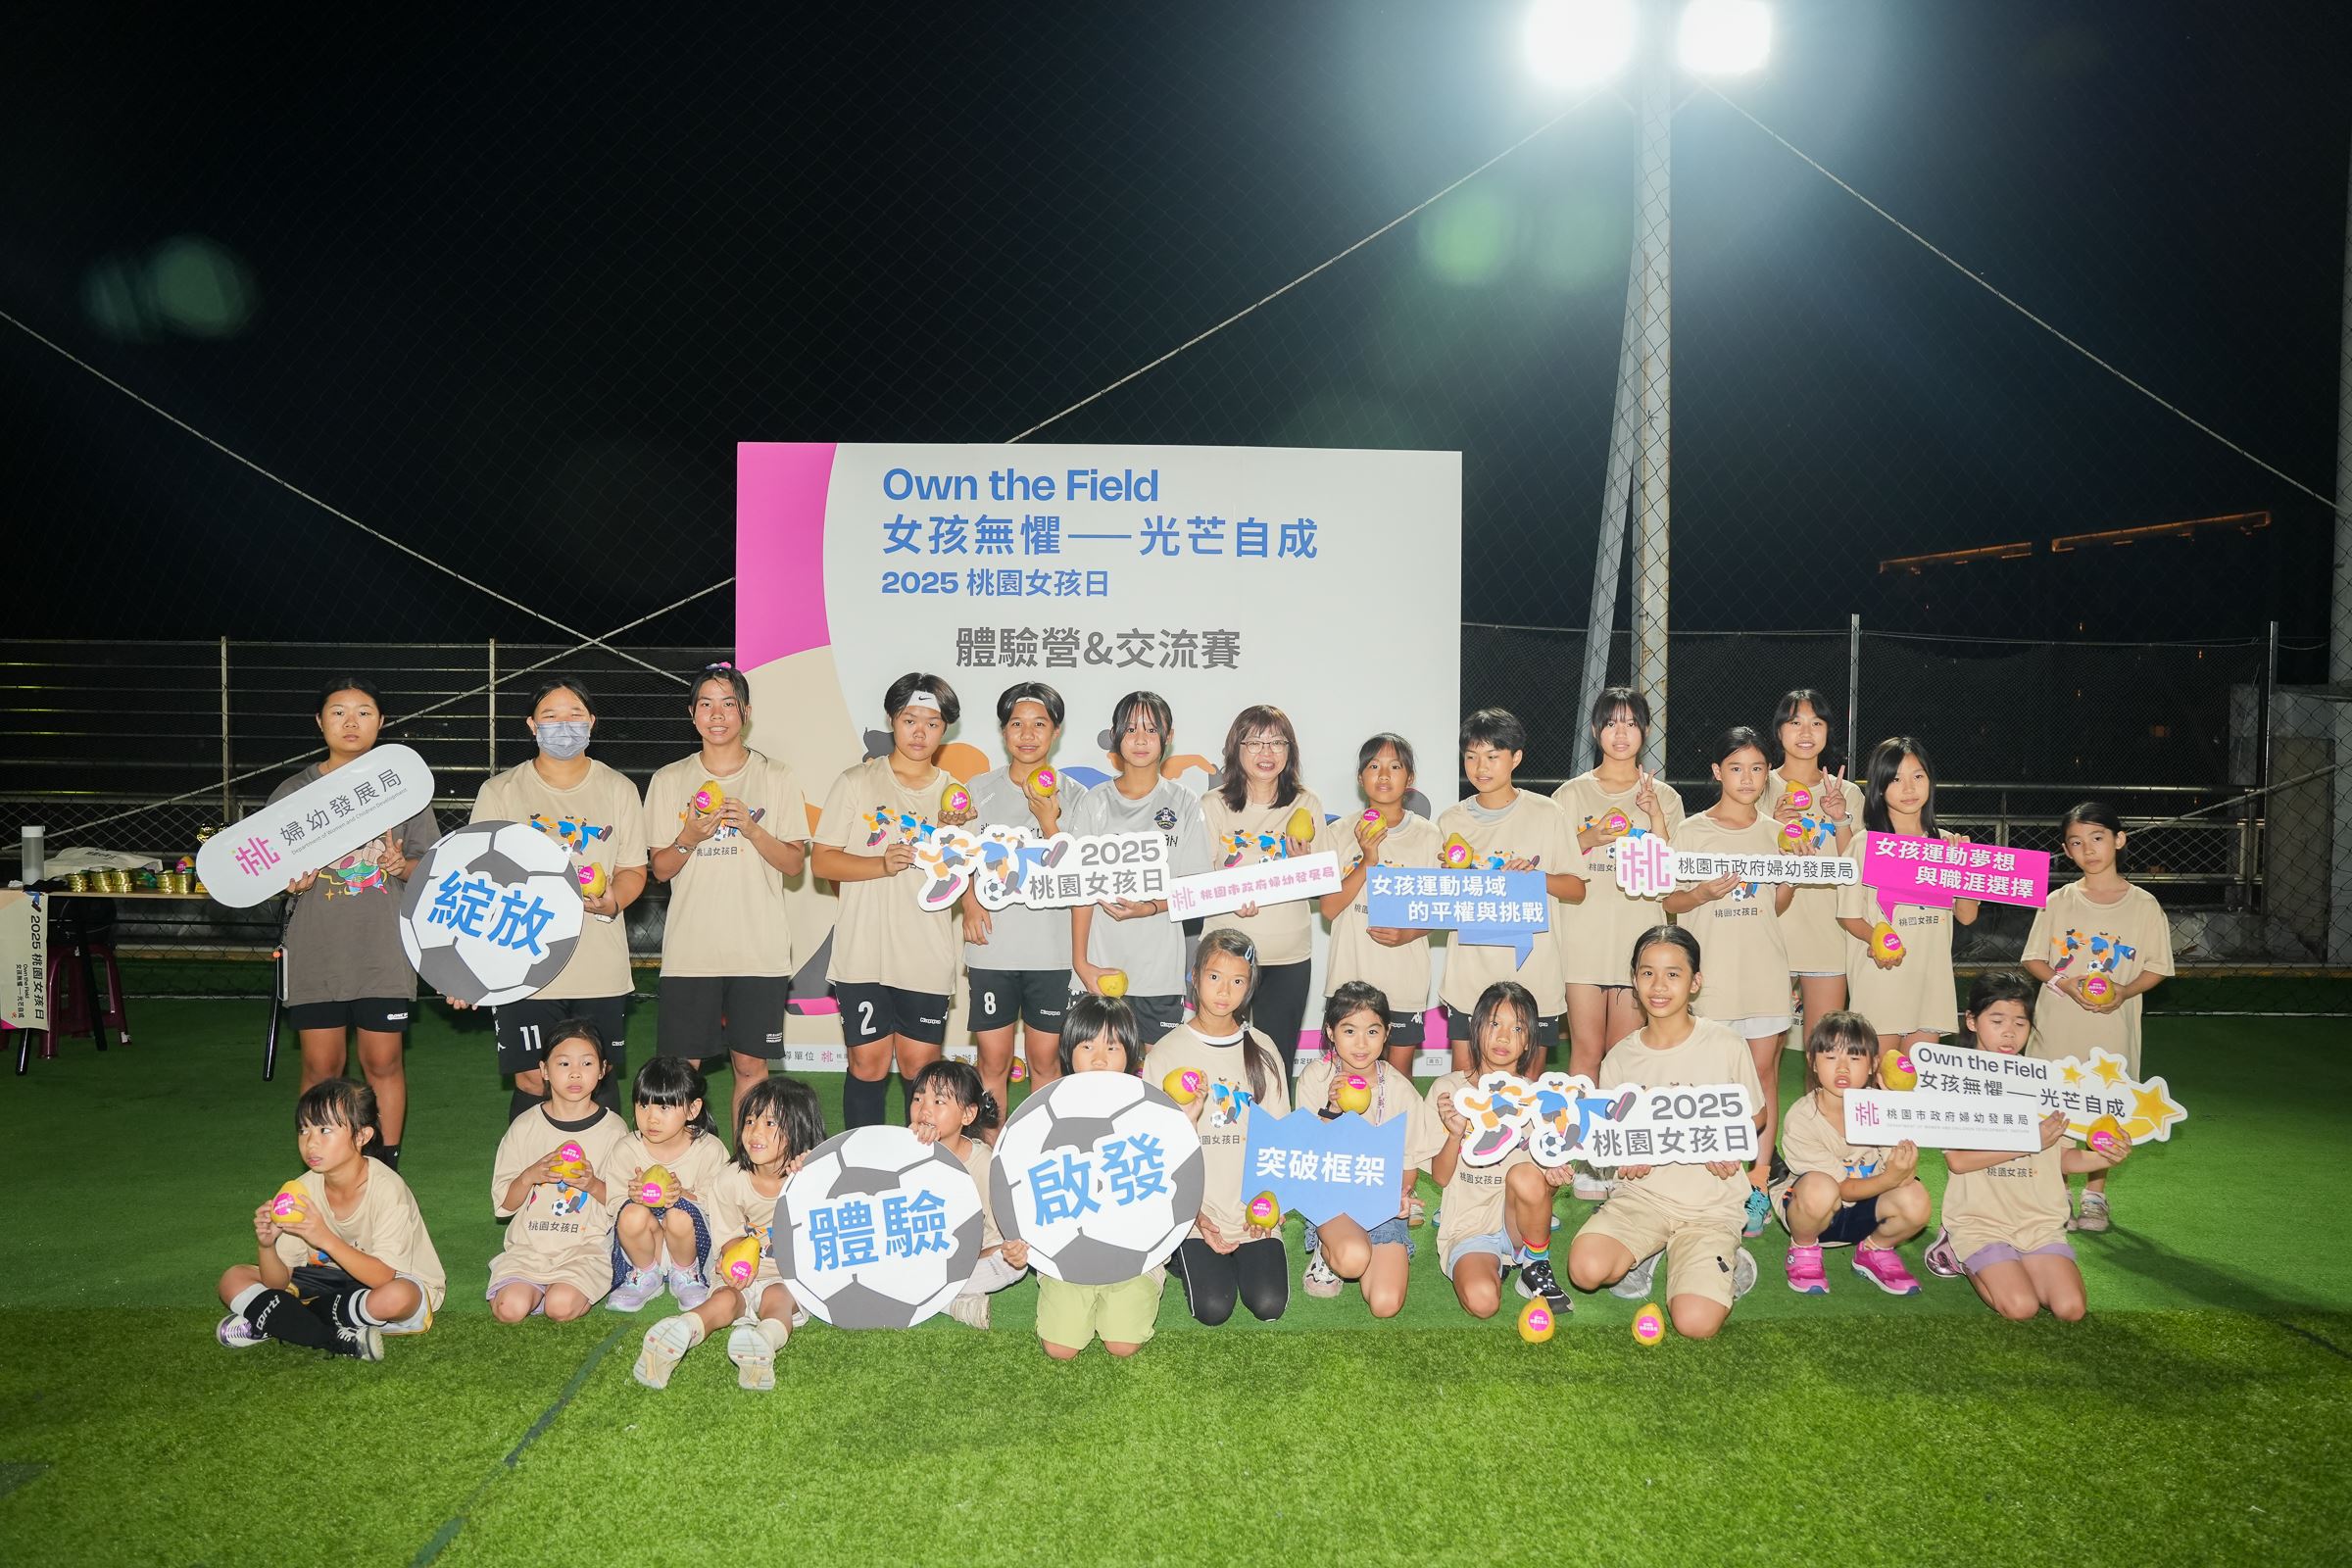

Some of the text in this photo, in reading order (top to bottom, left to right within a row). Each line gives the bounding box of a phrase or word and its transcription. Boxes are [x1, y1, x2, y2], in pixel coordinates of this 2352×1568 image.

[882, 467, 1159, 502] Own the Field
[881, 568, 1109, 597] 2025 桃園女孩日
[956, 626, 1242, 670] 體驗營&交流賽
[279, 768, 402, 847] 婦幼發展局
[291, 834, 321, 856] Department
[327, 819, 348, 835] Women
[355, 803, 376, 820] Children
[375, 787, 408, 809] Development
[1080, 838, 1161, 866] 2025
[1678, 857, 1854, 879] 桃園市政府婦幼發展局
[1875, 837, 2016, 872] 女孩運動夢想
[1029, 868, 1164, 901] 桃園女孩日
[1200, 865, 1336, 902] 桃園市政府婦幼發展局
[1371, 874, 1507, 898] 女孩運動場域
[1915, 865, 2034, 900] 與職涯選擇
[426, 869, 556, 956] 綻放
[1408, 901, 1544, 924] 的平權與挑戰
[30, 914, 45, 1020] 2025 桃園女孩日
[858, 1001, 878, 1037] 2
[983, 992, 997, 1015] 8
[519, 1024, 542, 1052] 11
[1918, 1047, 1962, 1068] Own
[1967, 1054, 1999, 1073] the
[2003, 1059, 2047, 1080] Field
[1650, 1092, 1743, 1121] 2025
[1886, 1107, 2030, 1126] 桃園市政府婦幼發展局
[1198, 1134, 1240, 1146] 園女孩日
[1592, 1124, 1750, 1158] 桃園女孩日
[1027, 1132, 1169, 1227] 啟發
[1255, 1147, 1386, 1187] 突破框架
[528, 1220, 579, 1234] 桃園女孩日
[808, 1189, 951, 1272] 體驗
